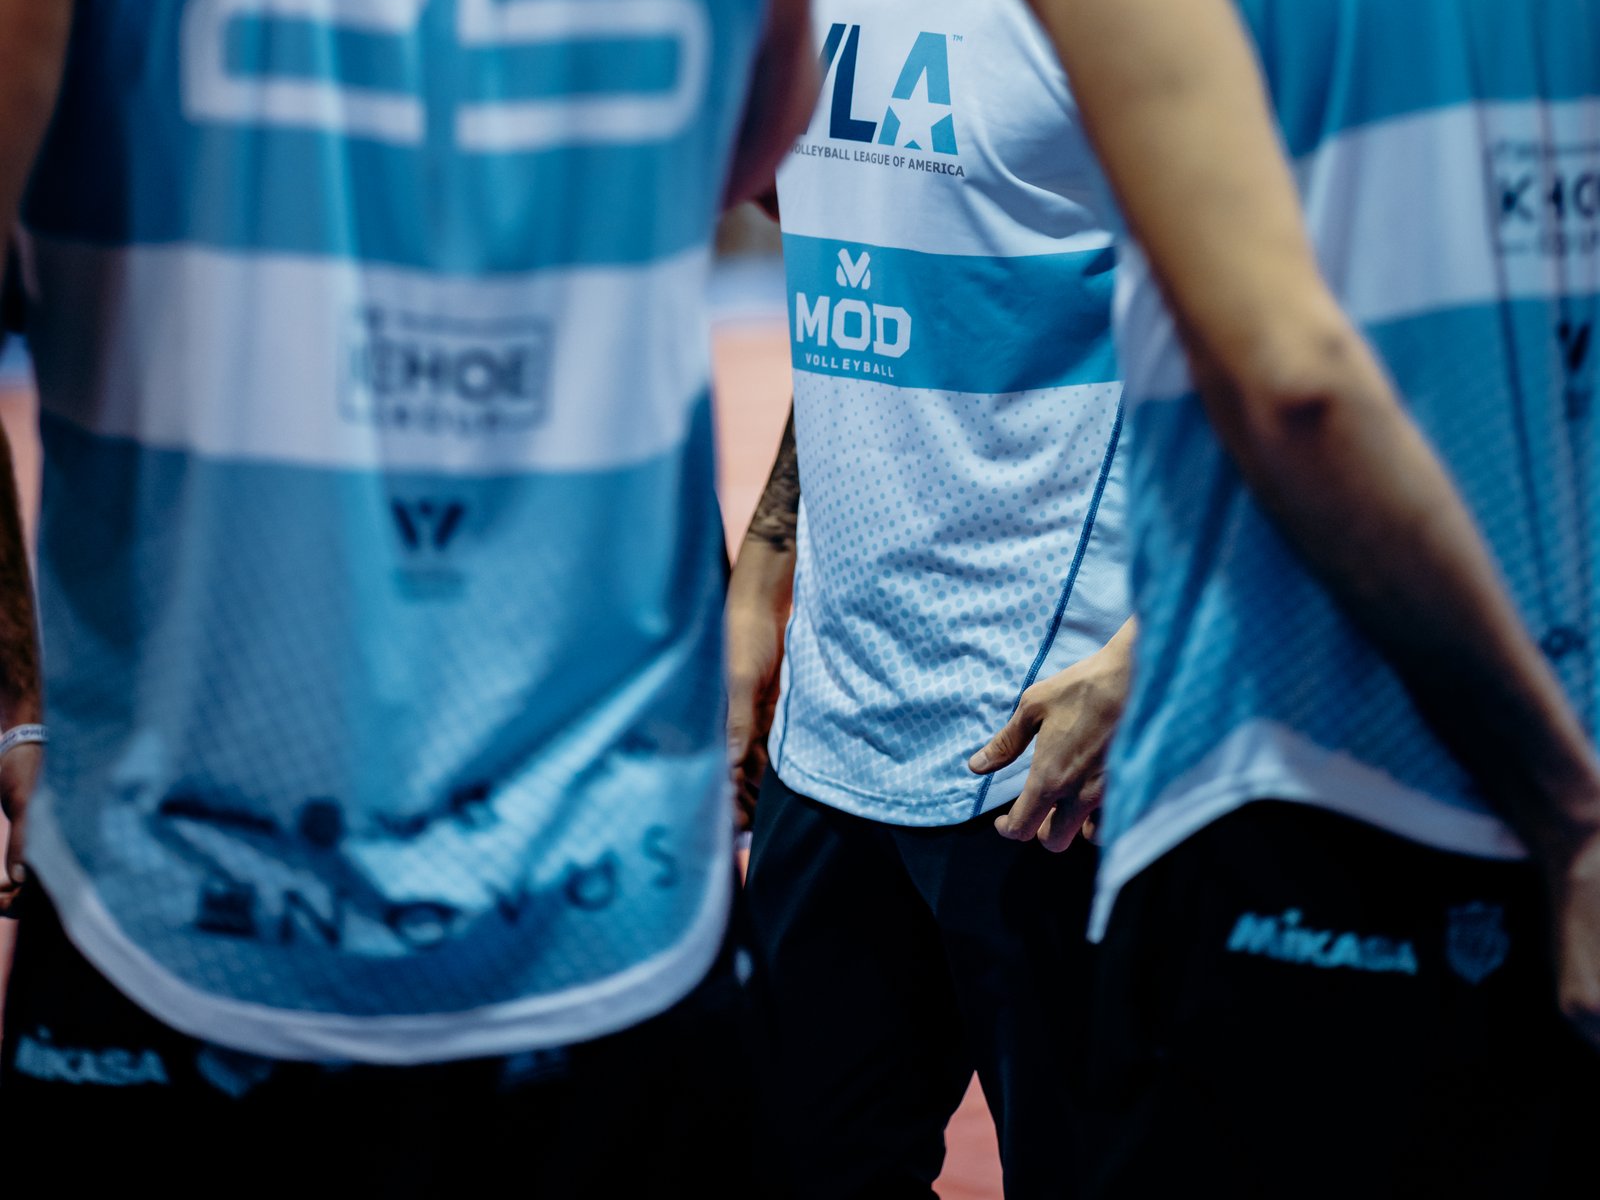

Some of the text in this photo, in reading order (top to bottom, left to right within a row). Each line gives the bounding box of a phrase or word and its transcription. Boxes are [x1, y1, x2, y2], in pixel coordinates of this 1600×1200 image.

[854, 150, 890, 167] LEAGUE
[892, 156, 906, 169] OF
[908, 158, 966, 178] AMERICA
[796, 291, 912, 359] MOD
[805, 352, 895, 378] VOLLEYBALL
